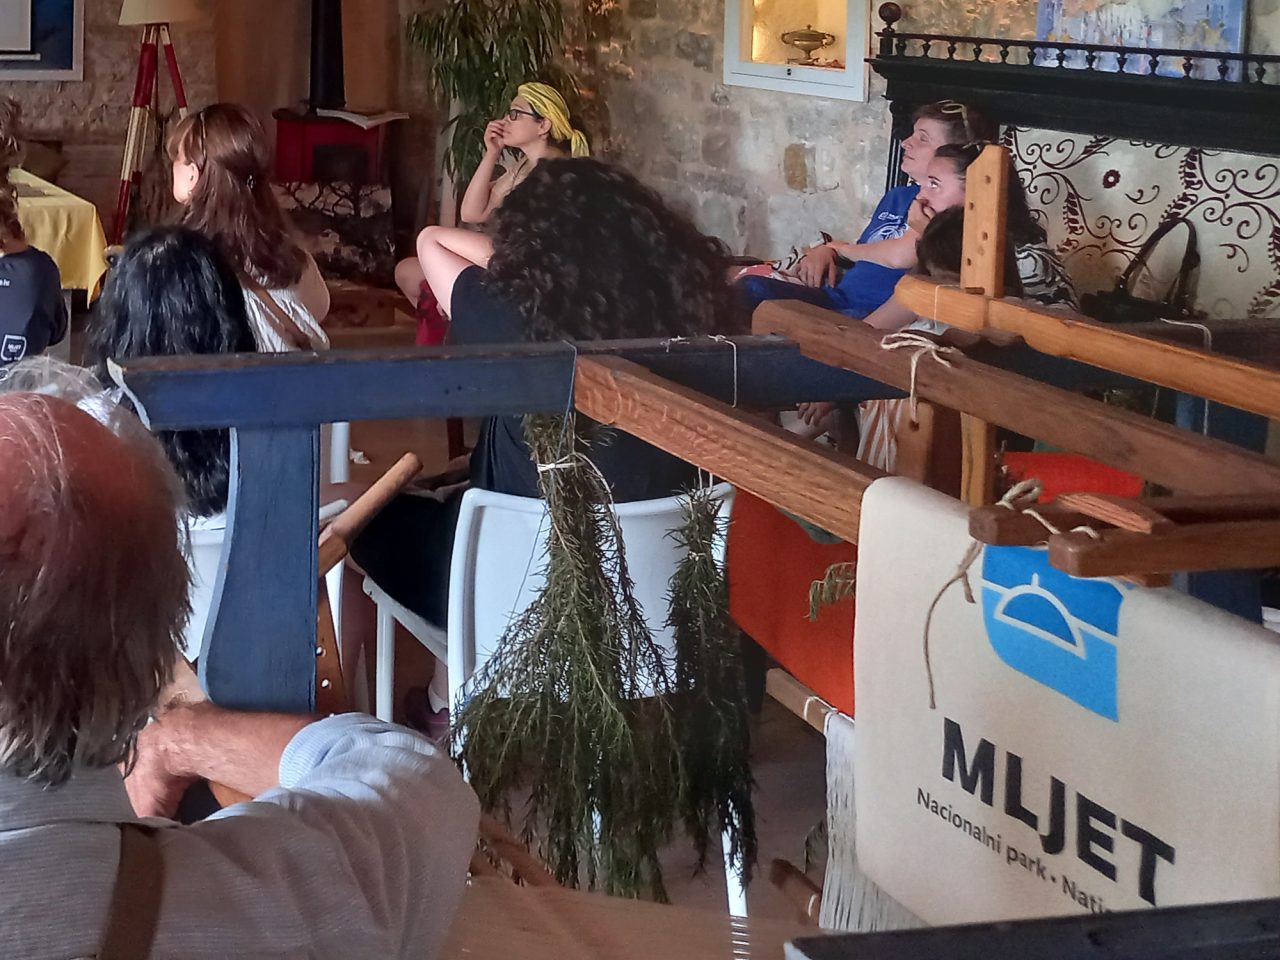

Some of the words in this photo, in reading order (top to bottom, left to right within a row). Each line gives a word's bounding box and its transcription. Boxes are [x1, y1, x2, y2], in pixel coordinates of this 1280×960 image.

[917, 787, 1001, 854] Nacionalni
[1006, 844, 1047, 881] park
[1062, 874, 1111, 915] Nati
[942, 717, 1175, 906] MLJET
